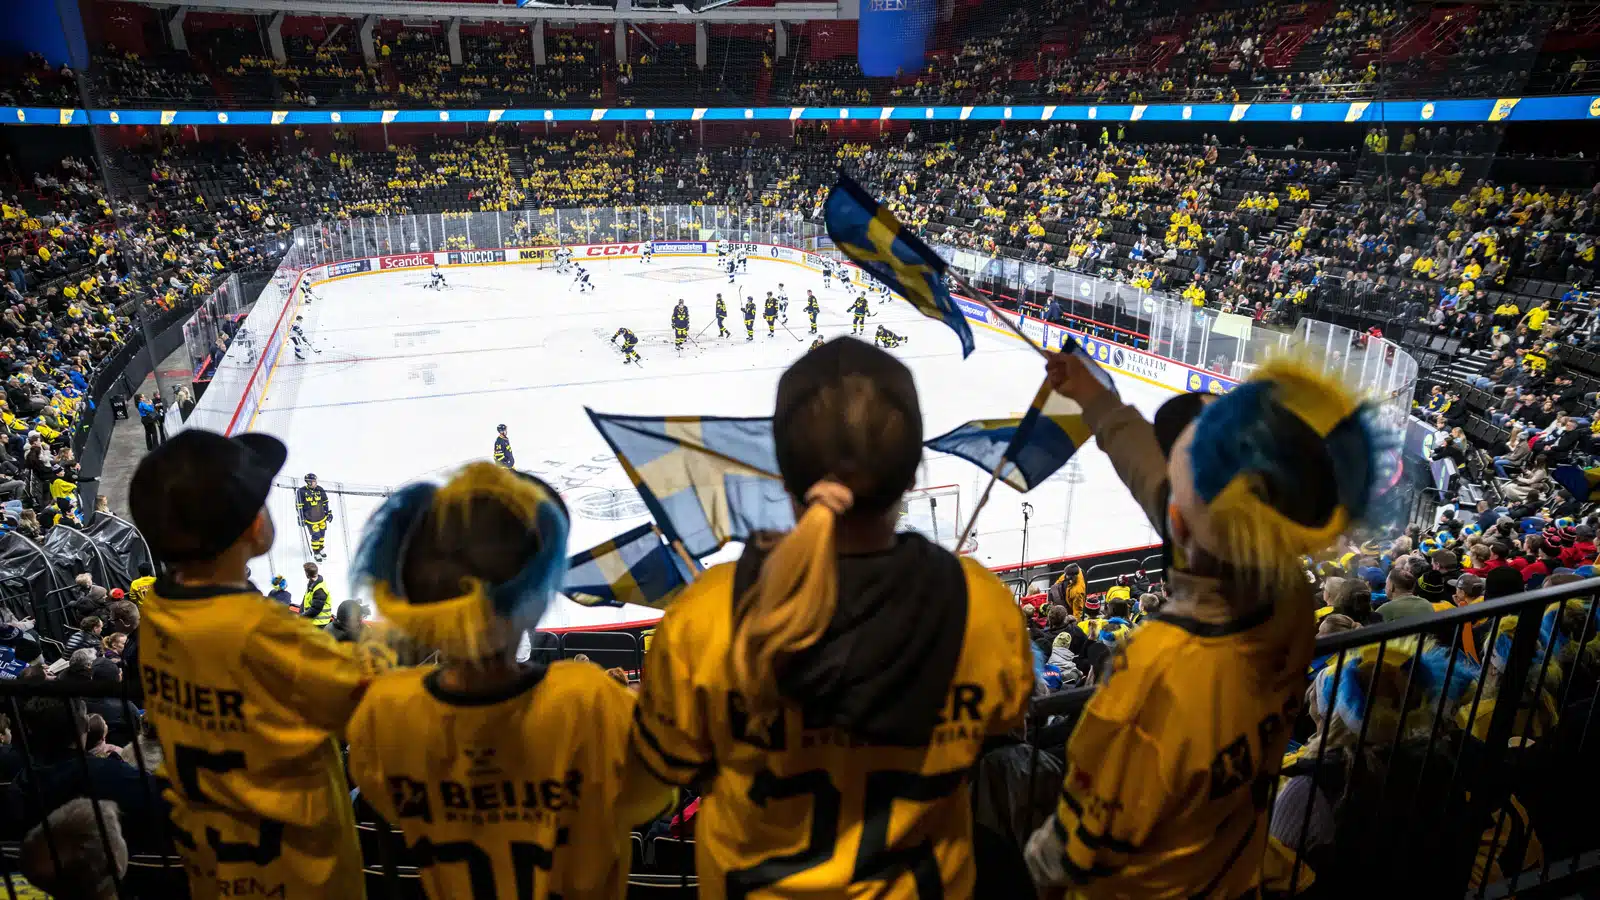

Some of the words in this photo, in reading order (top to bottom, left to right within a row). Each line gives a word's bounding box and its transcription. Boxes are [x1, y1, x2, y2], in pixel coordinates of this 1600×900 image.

[460, 251, 494, 264] NOCCO
[586, 245, 640, 256] CCM
[385, 255, 429, 268] Scandic
[1127, 353, 1167, 372] SERAFIM
[1127, 364, 1158, 379] FINANS
[143, 664, 245, 720] BEIJER
[216, 877, 286, 900] RENA
